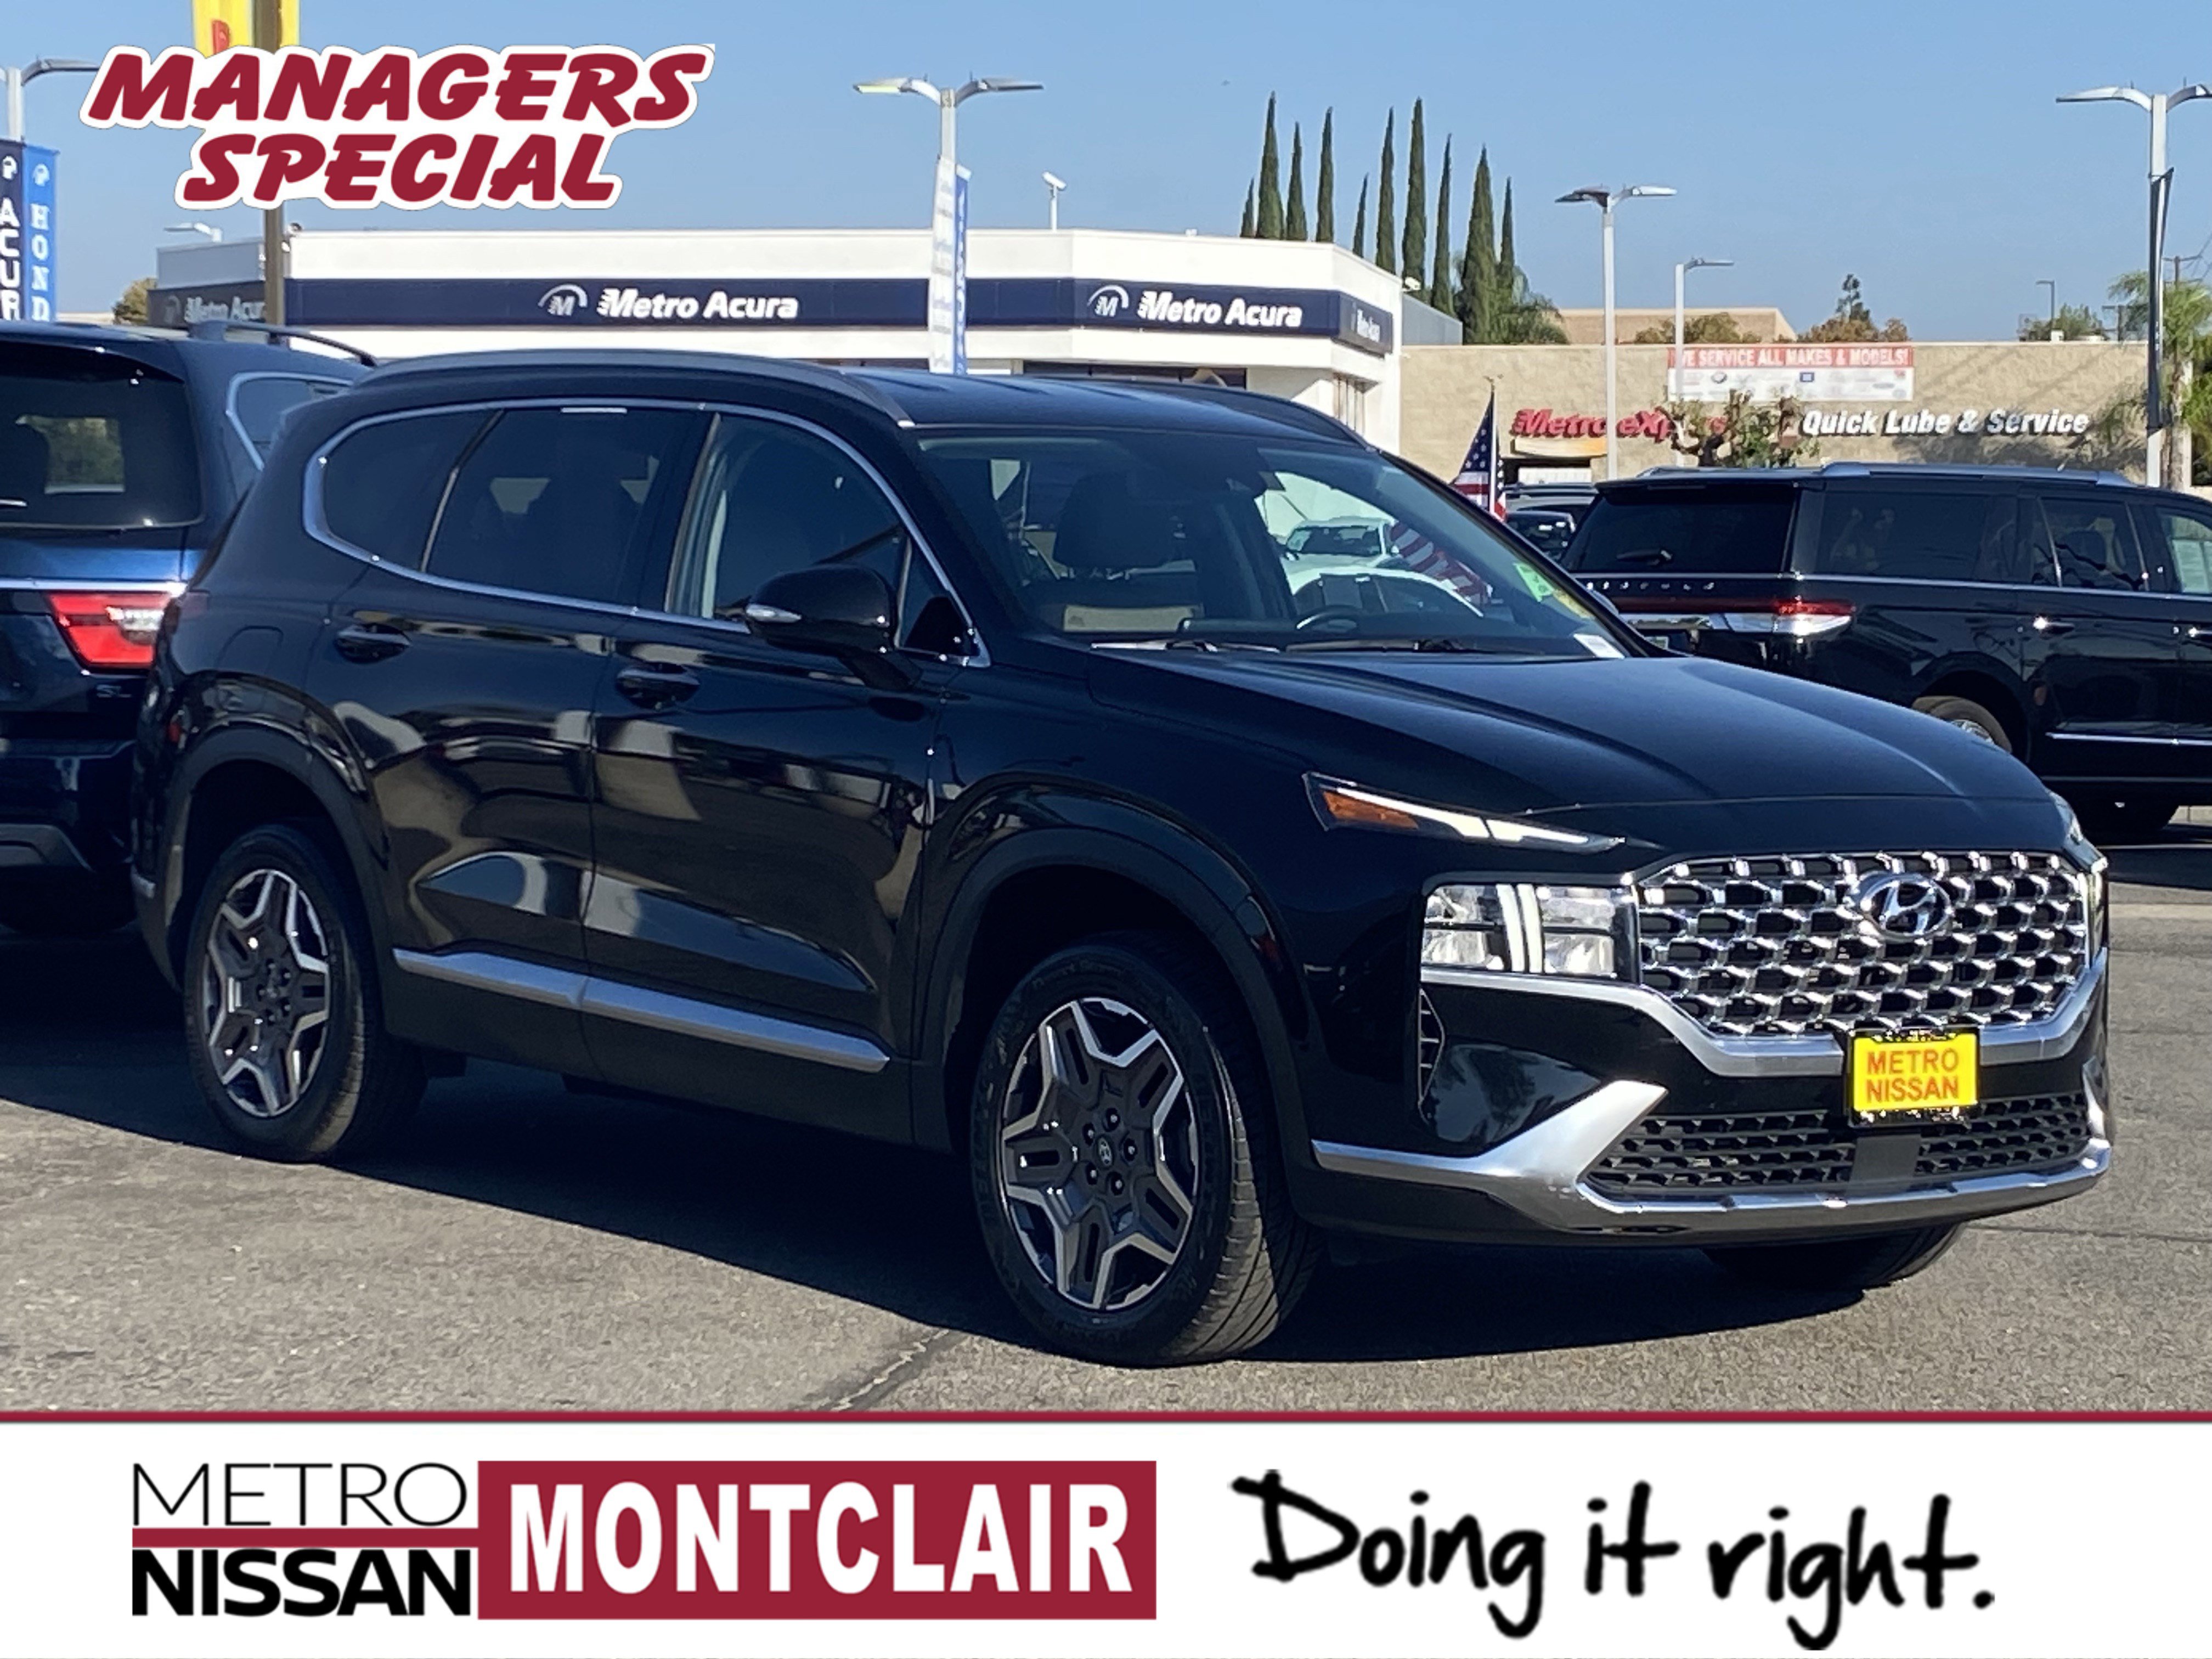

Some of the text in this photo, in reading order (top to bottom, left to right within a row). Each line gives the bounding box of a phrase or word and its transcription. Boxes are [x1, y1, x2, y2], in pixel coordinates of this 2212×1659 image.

[0, 196, 21, 321] ACUR
[31, 203, 50, 323] HOND
[596, 287, 799, 319] Metro Acura
[1137, 291, 1302, 328] Metro Acura
[1699, 348, 1755, 367] SERVICE
[1757, 348, 1785, 367] ALL
[1786, 348, 1832, 367] MAKES
[1510, 408, 1607, 437] Metro
[1801, 408, 2089, 436] Quick Lube & Service
[1866, 1047, 1959, 1075] METRO
[1866, 1074, 1959, 1103] NISSAN
